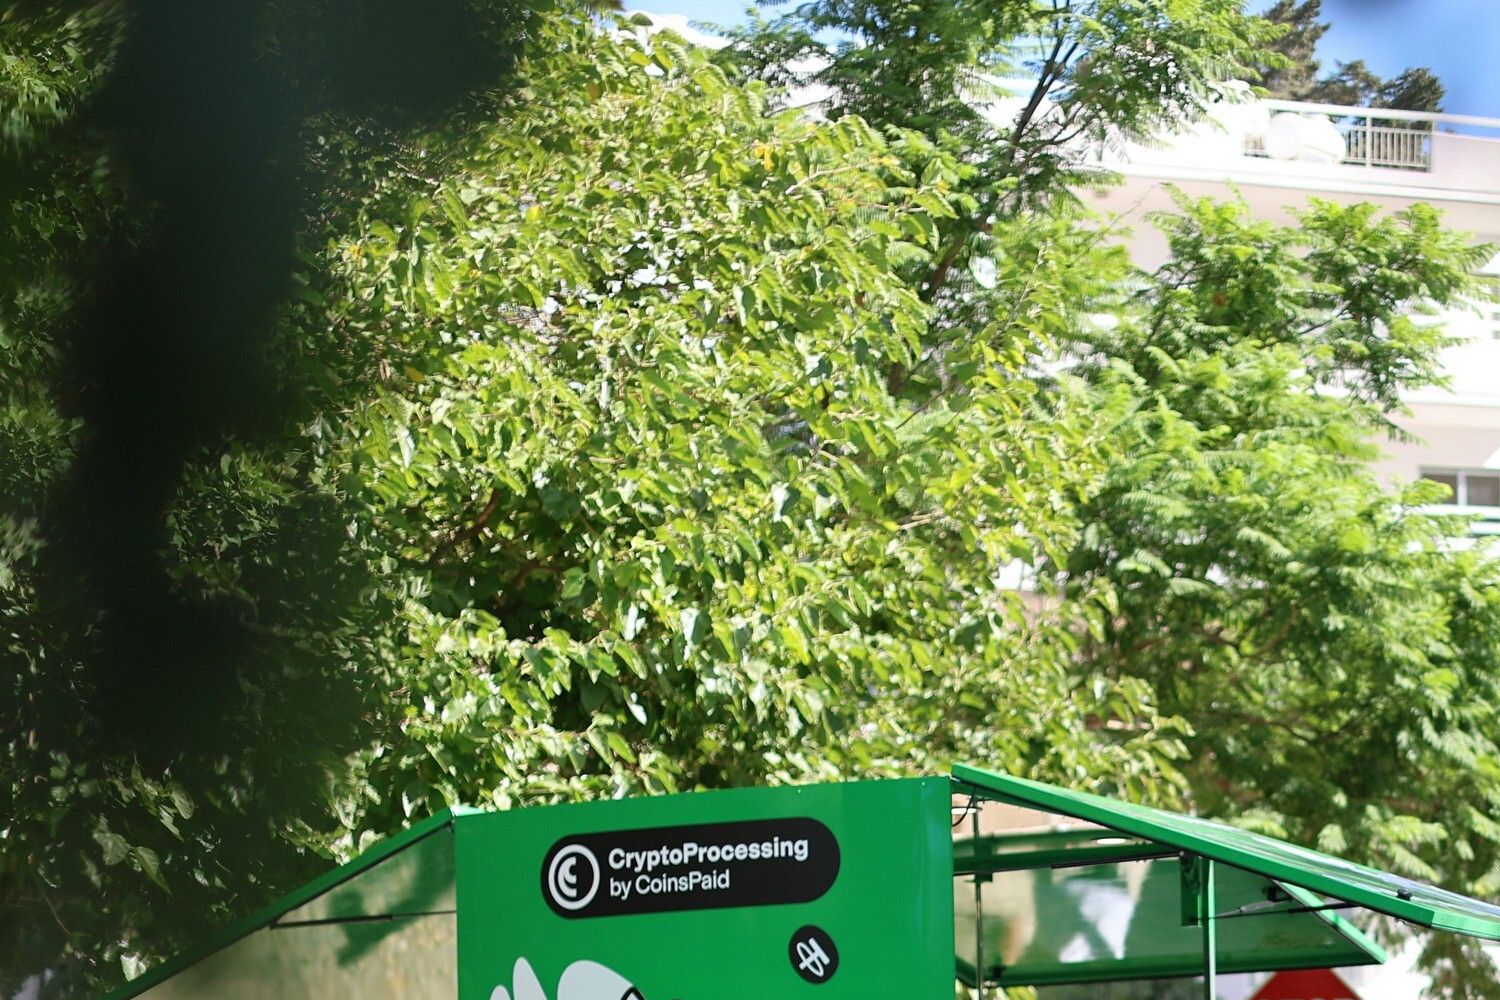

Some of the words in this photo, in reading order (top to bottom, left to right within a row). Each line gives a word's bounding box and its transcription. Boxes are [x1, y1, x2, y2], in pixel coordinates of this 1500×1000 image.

[608, 836, 809, 873] CryptoProcessing
[610, 876, 632, 900] by
[635, 868, 730, 895] CoinsPaid
